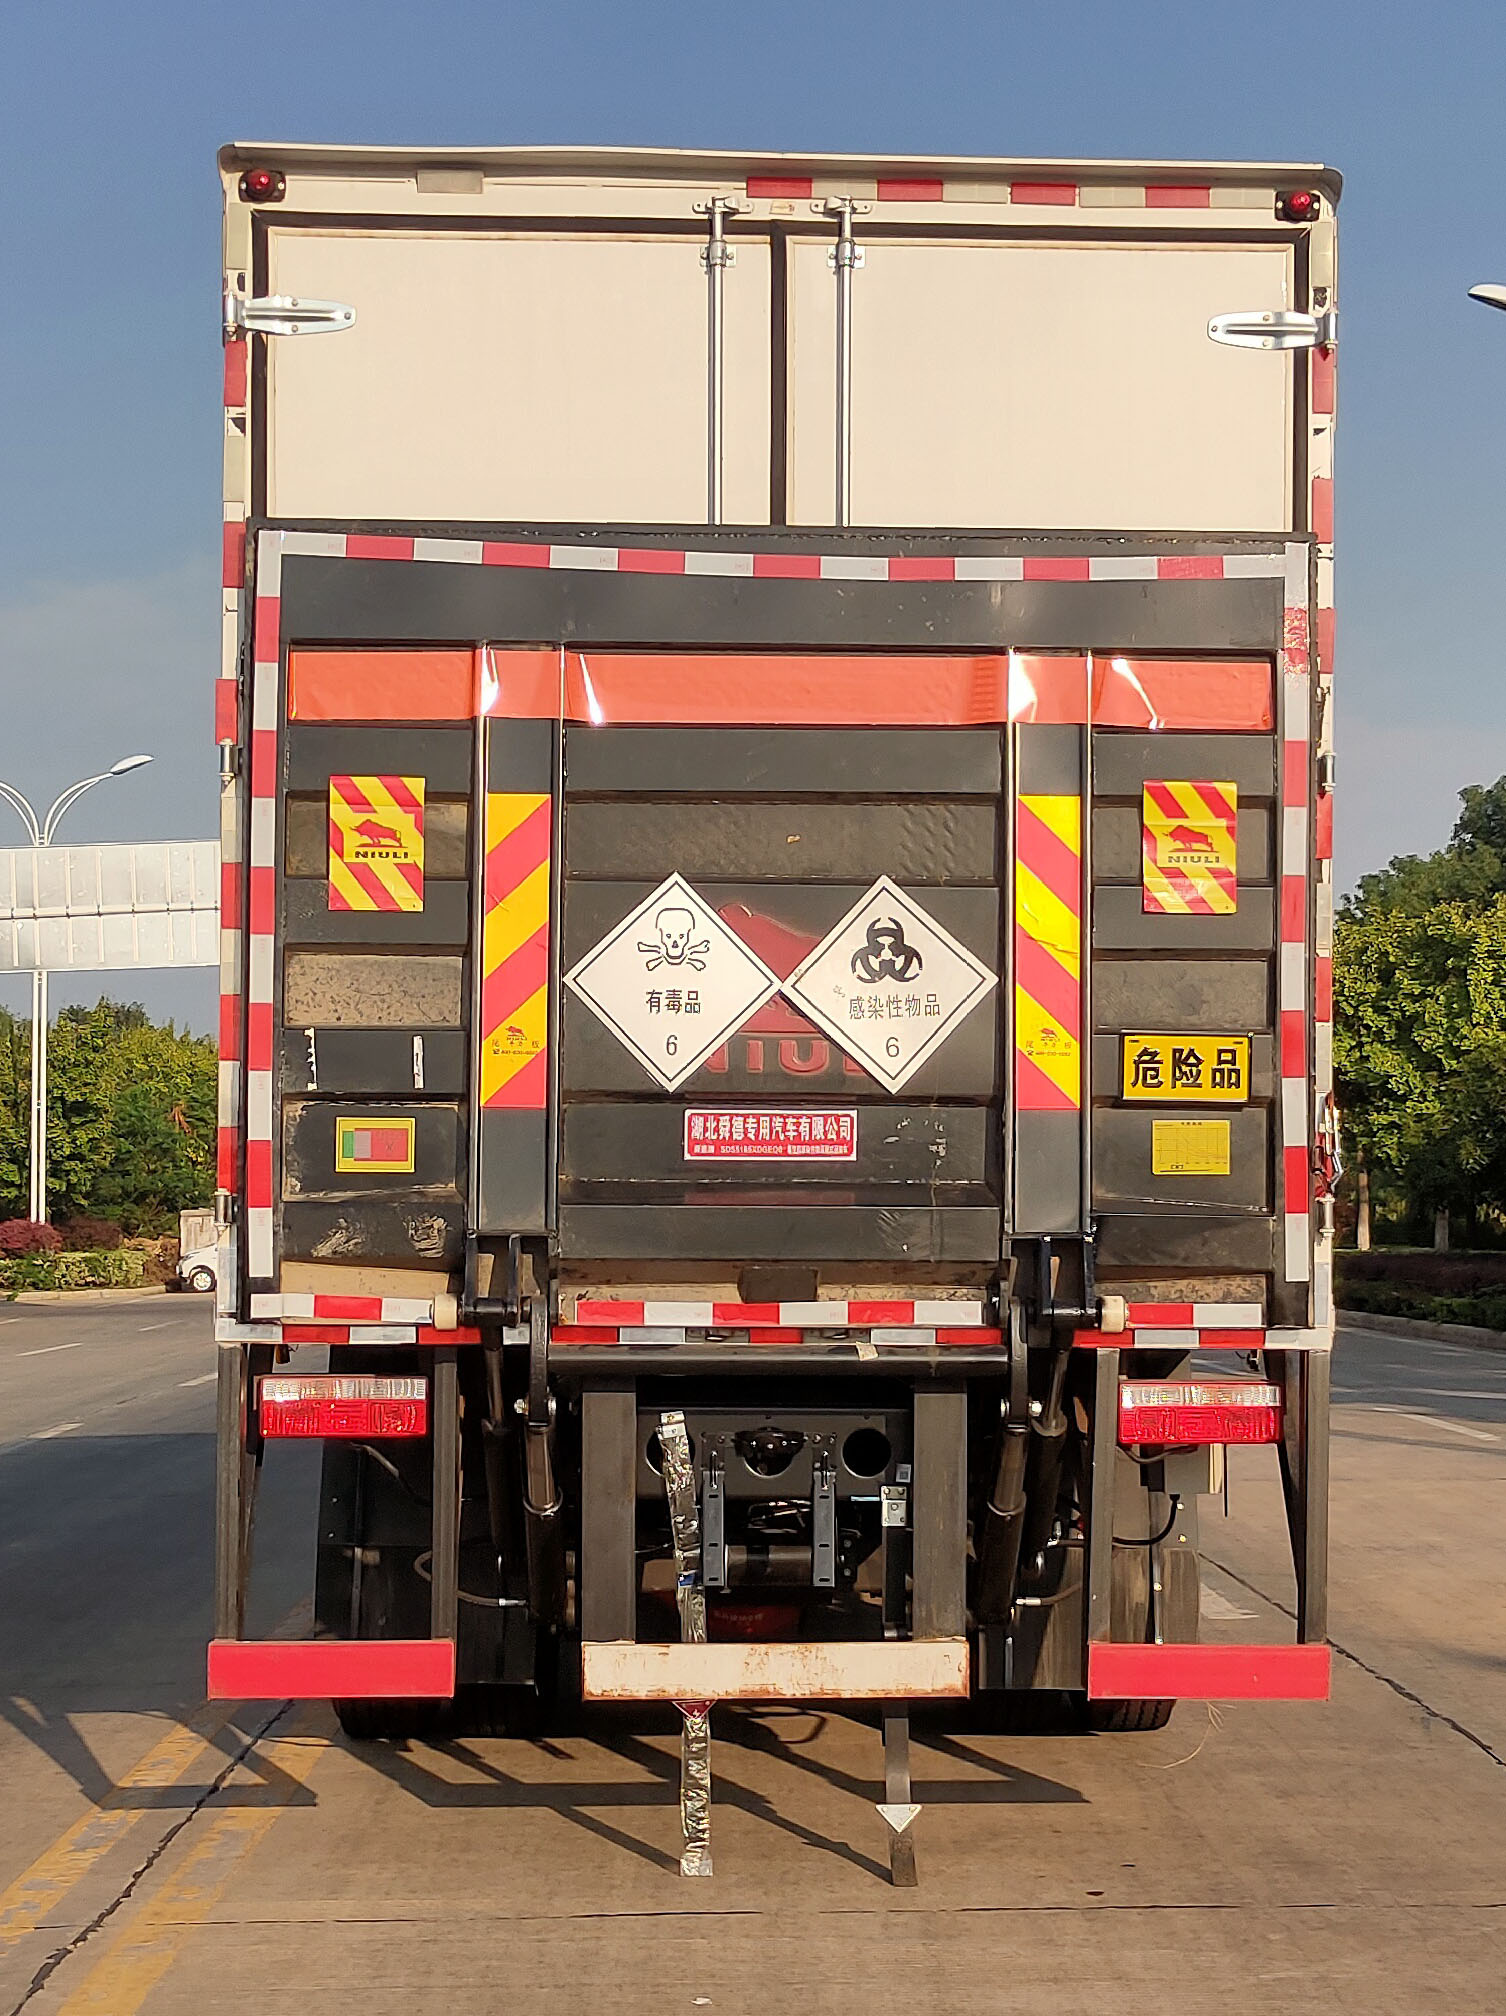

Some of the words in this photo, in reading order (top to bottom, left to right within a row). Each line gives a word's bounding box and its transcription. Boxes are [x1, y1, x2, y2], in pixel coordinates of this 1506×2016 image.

[354, 850, 409, 859] NIULI
[1167, 855, 1220, 864] NIULI
[645, 988, 701, 1015] 有毒品
[848, 992, 941, 1020] 感染性物品
[665, 1033, 680, 1056] 6
[884, 1035, 901, 1058] 6
[1130, 1046, 1241, 1090] 危险品
[690, 1114, 851, 1142] 湖北舜德专用汽车有限公司
